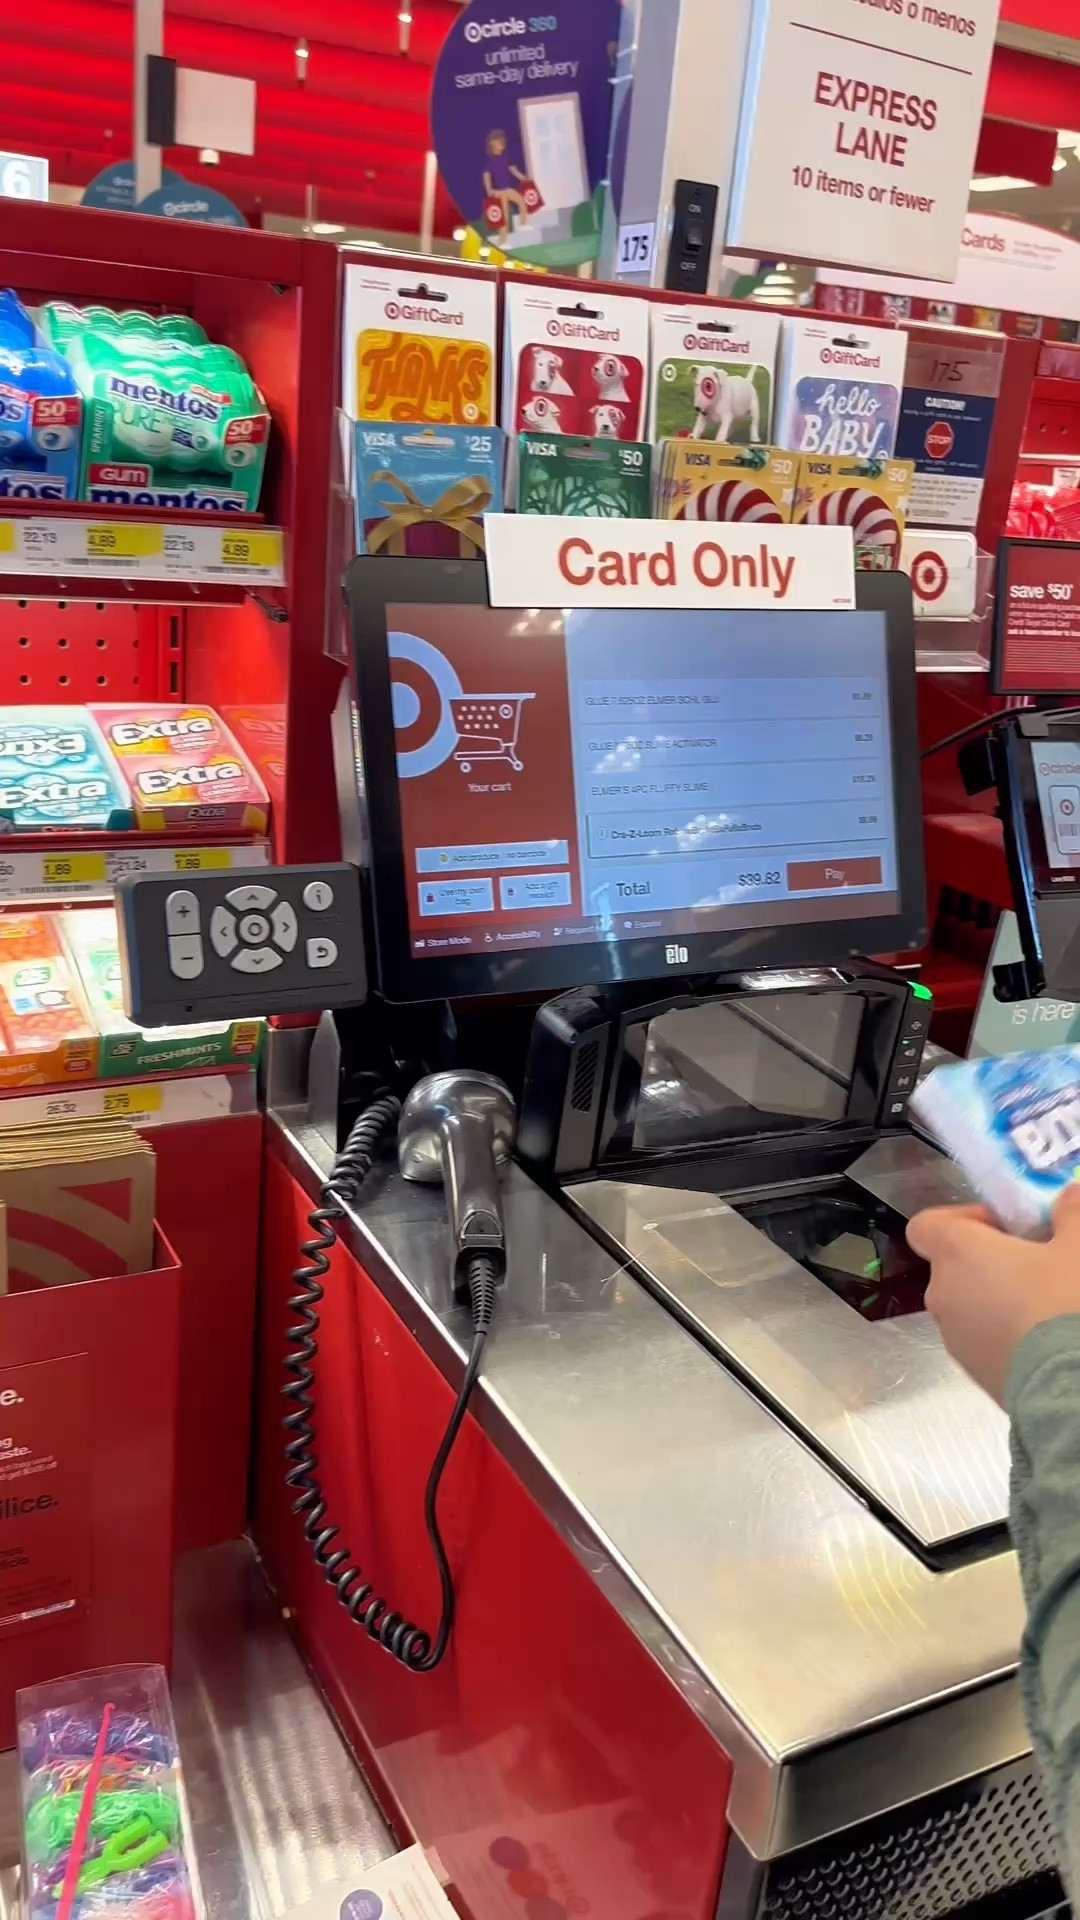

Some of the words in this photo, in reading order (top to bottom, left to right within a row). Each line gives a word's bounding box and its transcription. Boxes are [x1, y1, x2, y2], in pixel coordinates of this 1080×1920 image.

[481, 17, 526, 38] circle
[528, 16, 557, 32] 360
[907, 2, 919, 19] o
[921, 6, 976, 37] menos
[484, 44, 545, 66] unlimited
[454, 65, 525, 88] same-day
[527, 60, 579, 80] delivery
[814, 71, 938, 131] EXPRESS
[835, 121, 908, 167] LANE
[792, 165, 813, 188] 10
[815, 170, 864, 199] items
[868, 184, 887, 202] or
[890, 186, 936, 213] fewer
[621, 234, 649, 262] 175
[961, 227, 1006, 252] Cards
[402, 305, 464, 325] GiftCard
[563, 322, 620, 342] GiftCard
[699, 336, 751, 354] GiftCard
[831, 350, 881, 369] GiftCard
[929, 359, 971, 382] 175
[361, 333, 489, 420] THANKS
[37, 400, 66, 417] 50
[109, 376, 219, 421] mentos
[815, 383, 882, 417] hello
[227, 420, 254, 435] 50
[800, 414, 886, 460] BABY
[362, 430, 397, 447] VISA
[465, 435, 492, 452] $25
[926, 433, 953, 446] STOP
[526, 440, 558, 457] VISA
[618, 449, 644, 466] $50
[685, 452, 712, 467] VISA
[100, 467, 146, 484] GUM
[807, 462, 832, 475] VISA
[90, 489, 243, 512] mentos
[222, 544, 250, 557] 4.89
[557, 537, 678, 587] Card
[692, 541, 797, 600] Only
[1009, 585, 1045, 599] save
[111, 716, 214, 747] Extra
[136, 762, 244, 795] Extra
[467, 783, 489, 793] Your
[490, 782, 512, 792] cart
[0, 780, 107, 810] Extra
[44, 863, 72, 876] 1.89
[176, 858, 200, 869] 1.89
[616, 881, 651, 897] Total
[738, 871, 781, 887] $39.82
[824, 867, 845, 881] Pay
[449, 936, 472, 945] Mode
[1011, 1004, 1028, 1025] is
[1031, 1001, 1076, 1023] here
